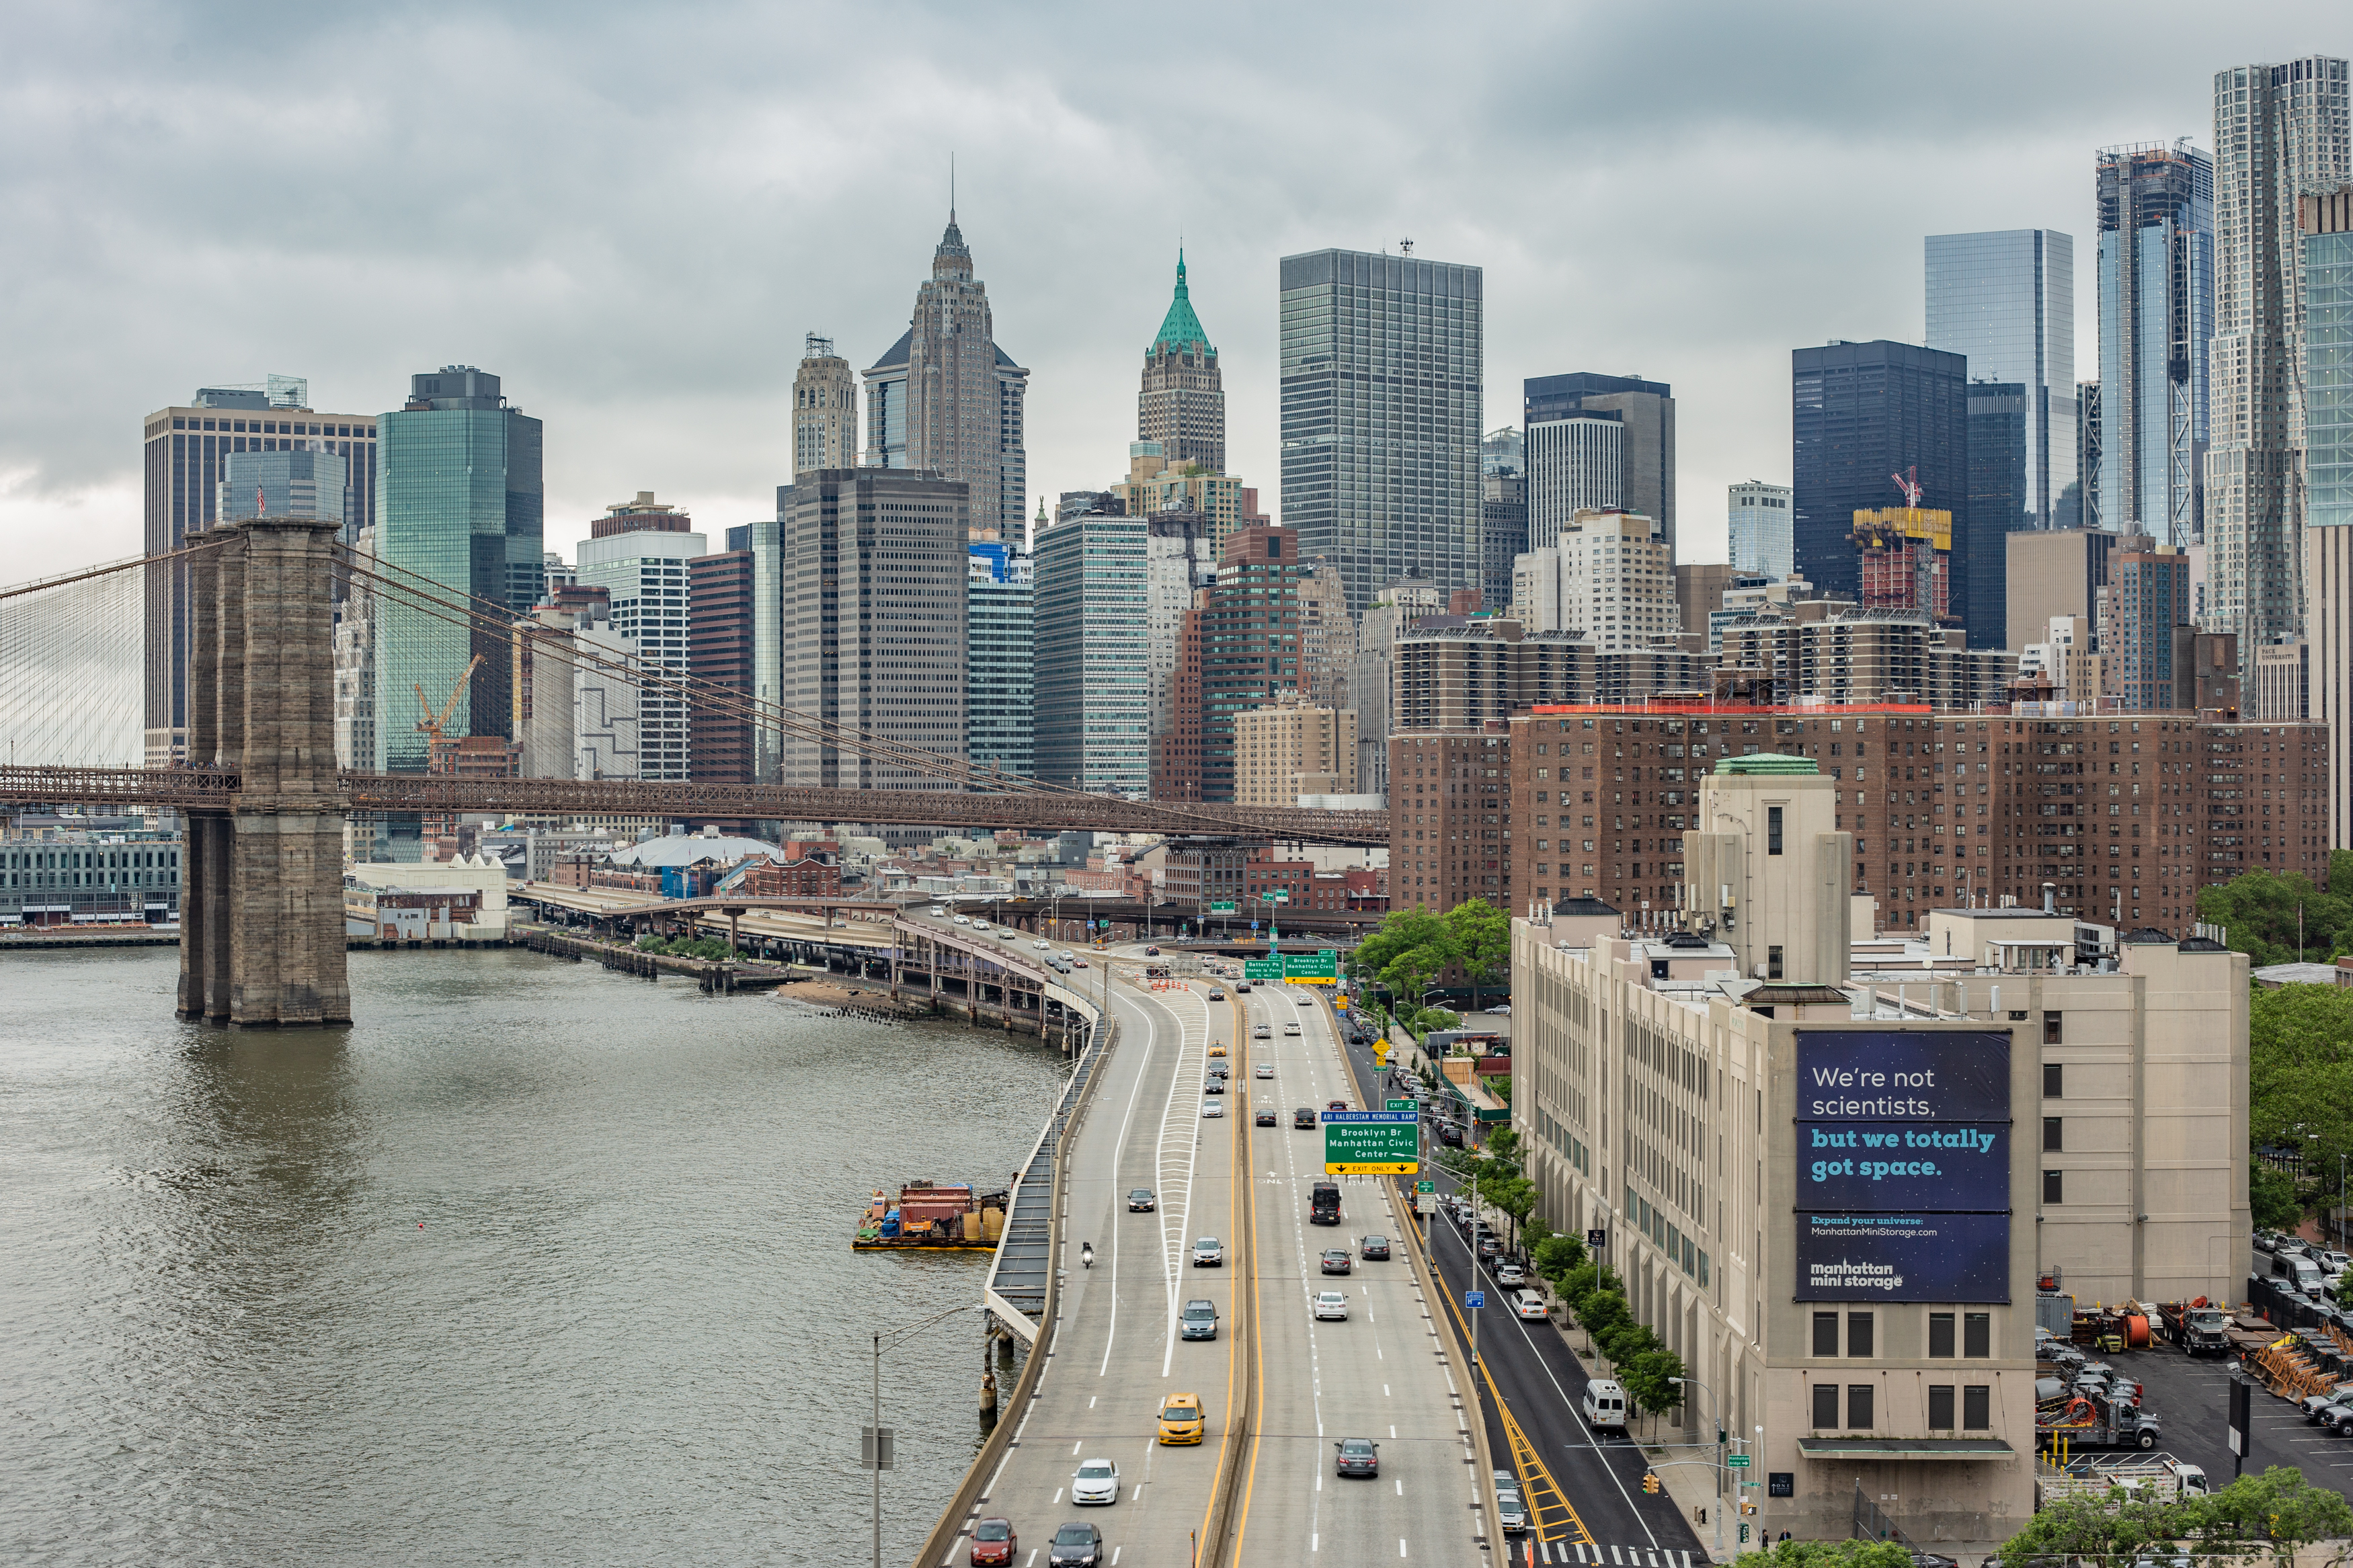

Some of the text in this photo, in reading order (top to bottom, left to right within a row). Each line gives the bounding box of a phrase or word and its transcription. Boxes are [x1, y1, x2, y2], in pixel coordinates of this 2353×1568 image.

[1812, 1067, 1935, 1087] We’re not
[1812, 1096, 1936, 1117] scientists,
[1341, 1129, 1386, 1137] Brooklyn
[1811, 1129, 1995, 1153] but we totally
[1811, 1158, 1942, 1182] got space.
[1811, 1216, 1850, 1226] Expand
[1876, 1217, 1923, 1225] universe:
[1811, 1227, 1938, 1238] ManhattanMiniStorage.com
[1810, 1261, 1893, 1275] manhattan
[1810, 1274, 1903, 1290] mini storage
